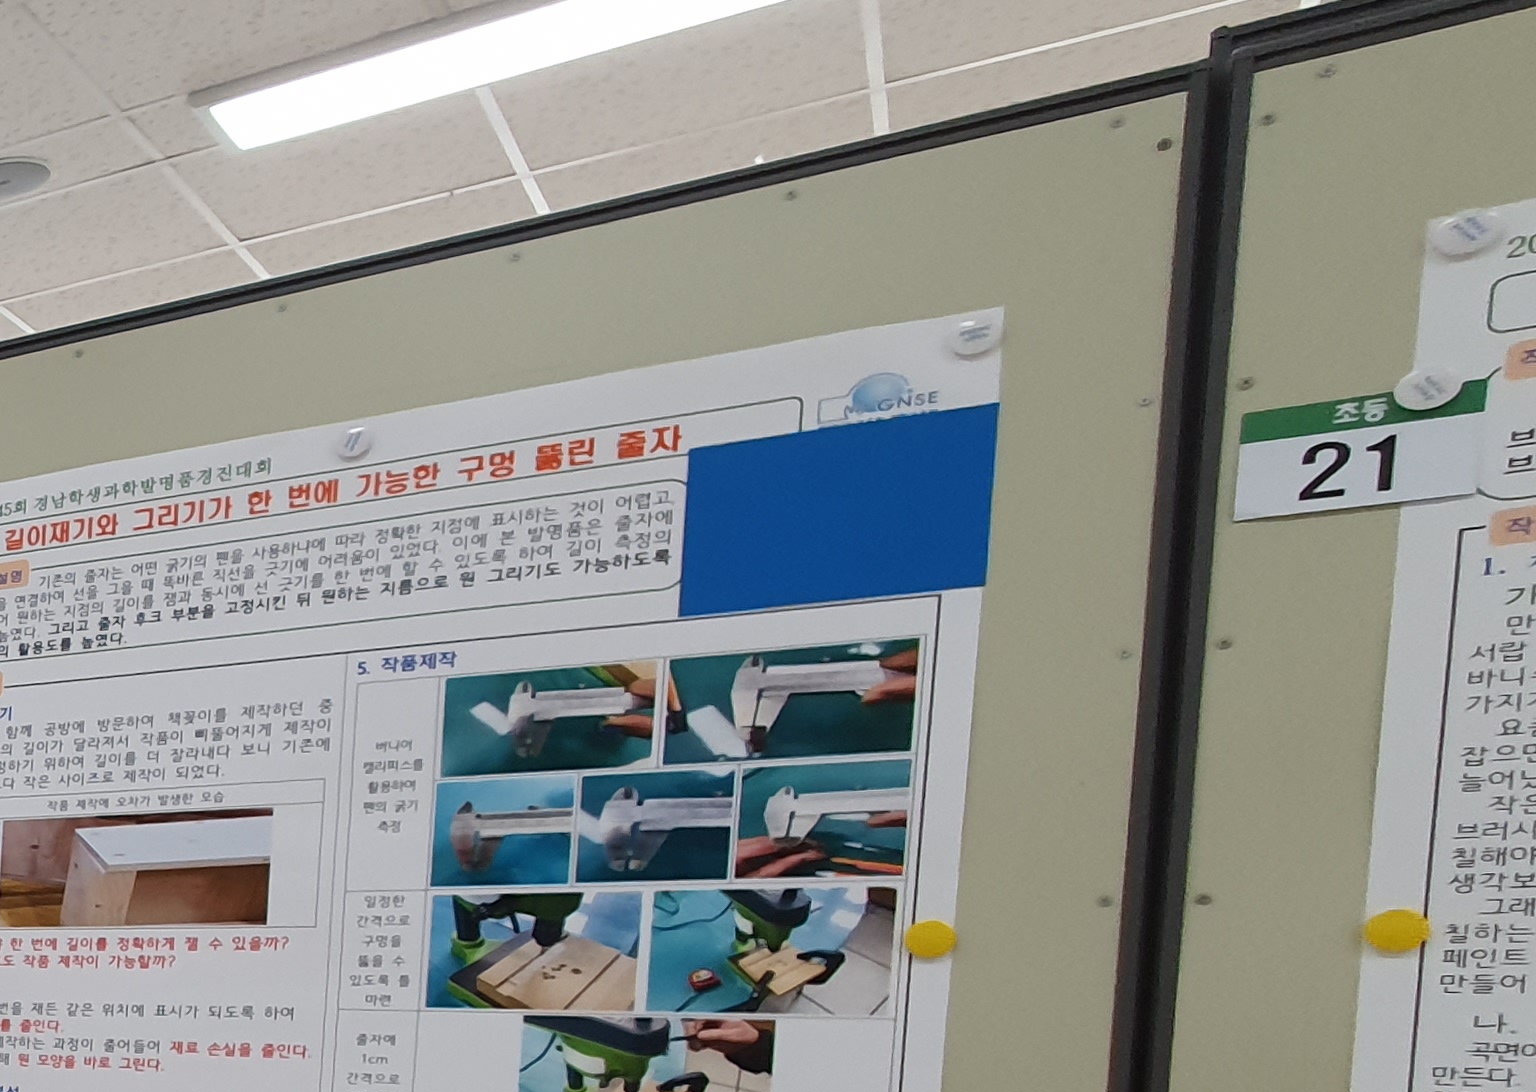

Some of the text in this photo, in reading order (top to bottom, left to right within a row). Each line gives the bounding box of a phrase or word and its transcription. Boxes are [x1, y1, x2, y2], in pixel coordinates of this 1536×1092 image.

[1333, 398, 1388, 425] 초등
[1298, 434, 1398, 501] 21
[6, 425, 682, 552] 길이재기와 그리기가 한 번에 가능한 구멍 뚫린 줄자
[33, 457, 273, 509] 경남학생과학발명품경진대회
[46, 615, 89, 636] 그리고
[97, 615, 126, 632] 줄자
[133, 610, 162, 627] 후크
[170, 603, 216, 622] 부분을
[224, 594, 286, 615] 고정시킨
[296, 592, 311, 608] 뒤
[321, 586, 371, 605] 원하는
[380, 575, 449, 597] 지름으로
[459, 571, 476, 588] 원
[486, 561, 562, 583] 그리기도
[572, 549, 672, 575] 가능하도록
[18, 637, 72, 657] 활용도를
[81, 632, 127, 650] 높였다.
[1470, 641, 1526, 663] 서랍
[357, 650, 458, 676] 5. 작품제작
[1444, 923, 1535, 944] 칠하는
[9, 938, 23, 950] 한
[31, 938, 59, 951] 번에
[68, 937, 109, 953] 길이를
[118, 937, 176, 952] 정확하게
[210, 939, 221, 950] 수
[233, 937, 290, 953] 있을까?
[24, 955, 51, 970] 작품
[59, 955, 100, 969] 제작이
[111, 954, 176, 971] 가능할까?
[1442, 949, 1530, 969] 페인트
[1440, 973, 1527, 994] 만들어
[30, 1002, 58, 1017] 재든
[66, 1002, 94, 1018] 같은
[102, 1003, 145, 1018] 위치에
[153, 1004, 200, 1020] 표시가
[208, 1005, 255, 1021] 되도록
[264, 1005, 295, 1022] 하여
[18, 1018, 65, 1035] 줄인다.
[1473, 1013, 1517, 1034] 나.
